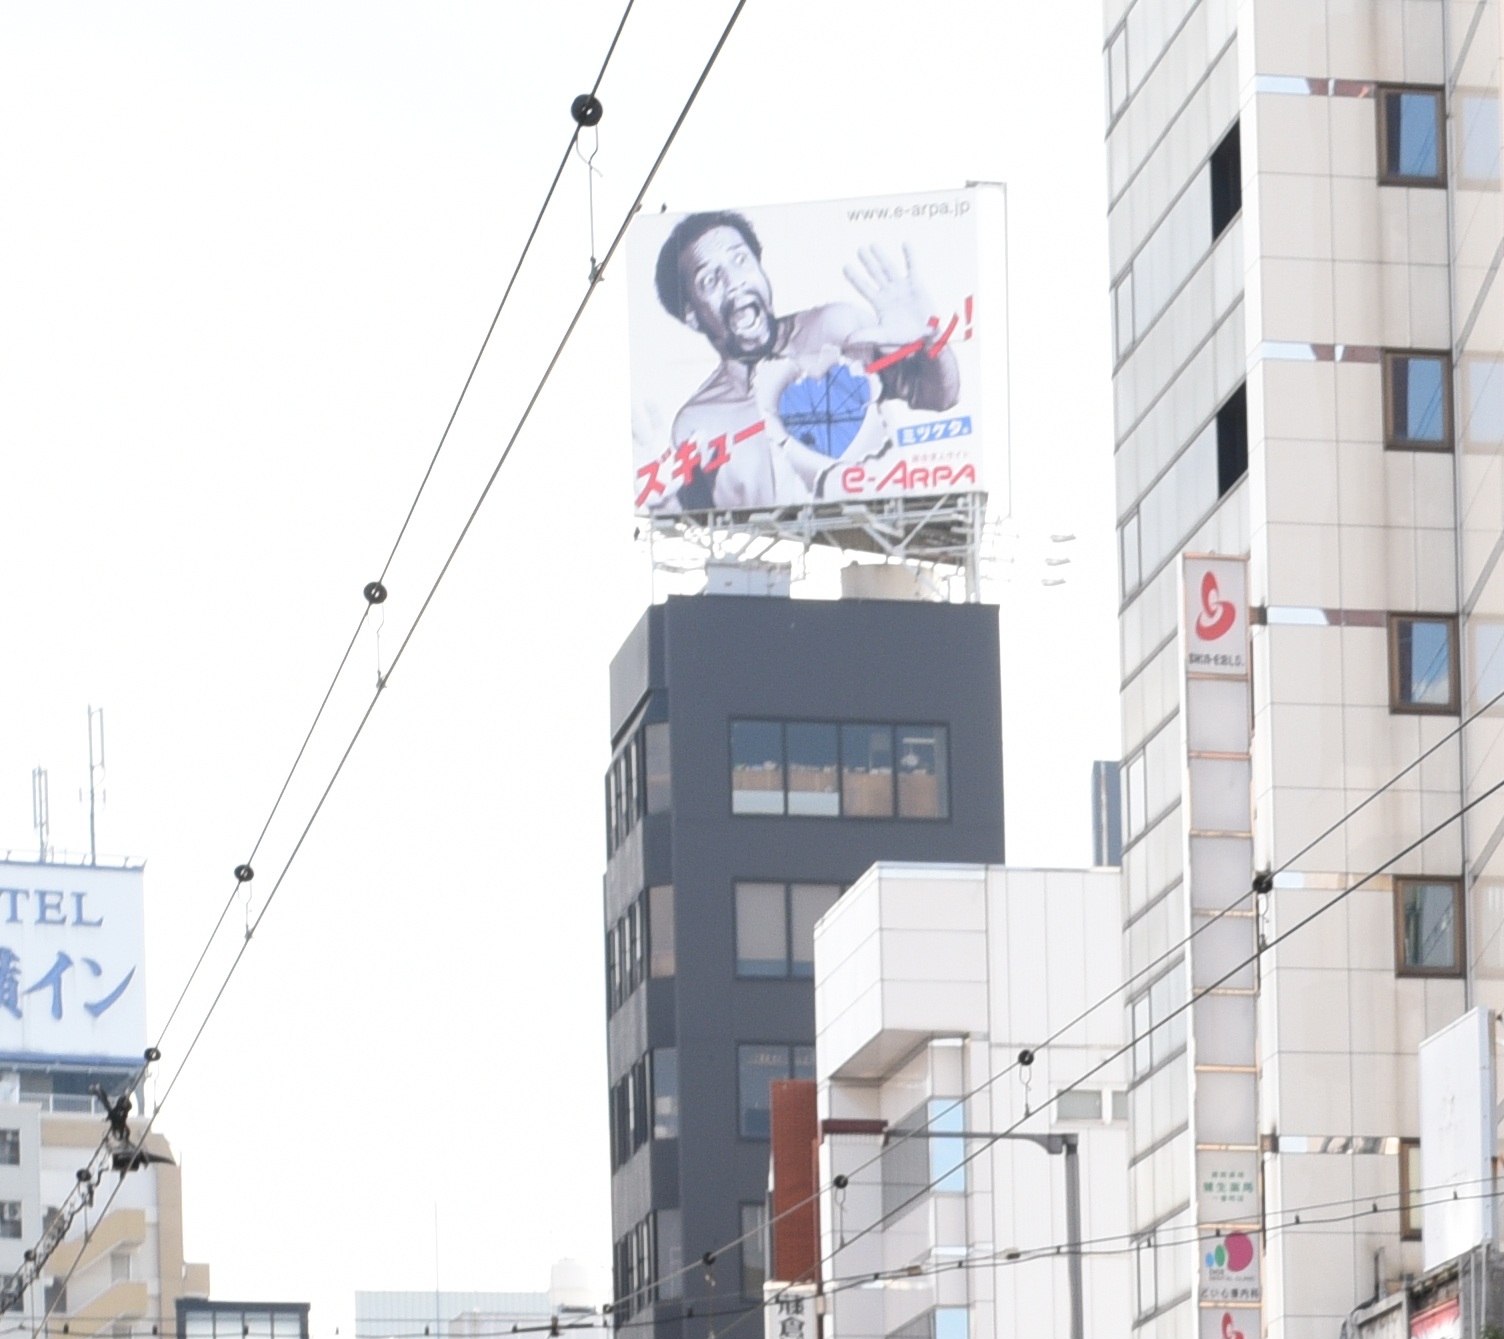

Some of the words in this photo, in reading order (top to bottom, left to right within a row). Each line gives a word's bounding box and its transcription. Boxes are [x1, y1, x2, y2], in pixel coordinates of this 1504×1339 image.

[847, 198, 970, 222] www.e-arpa.jp
[636, 420, 766, 507] ズキュー
